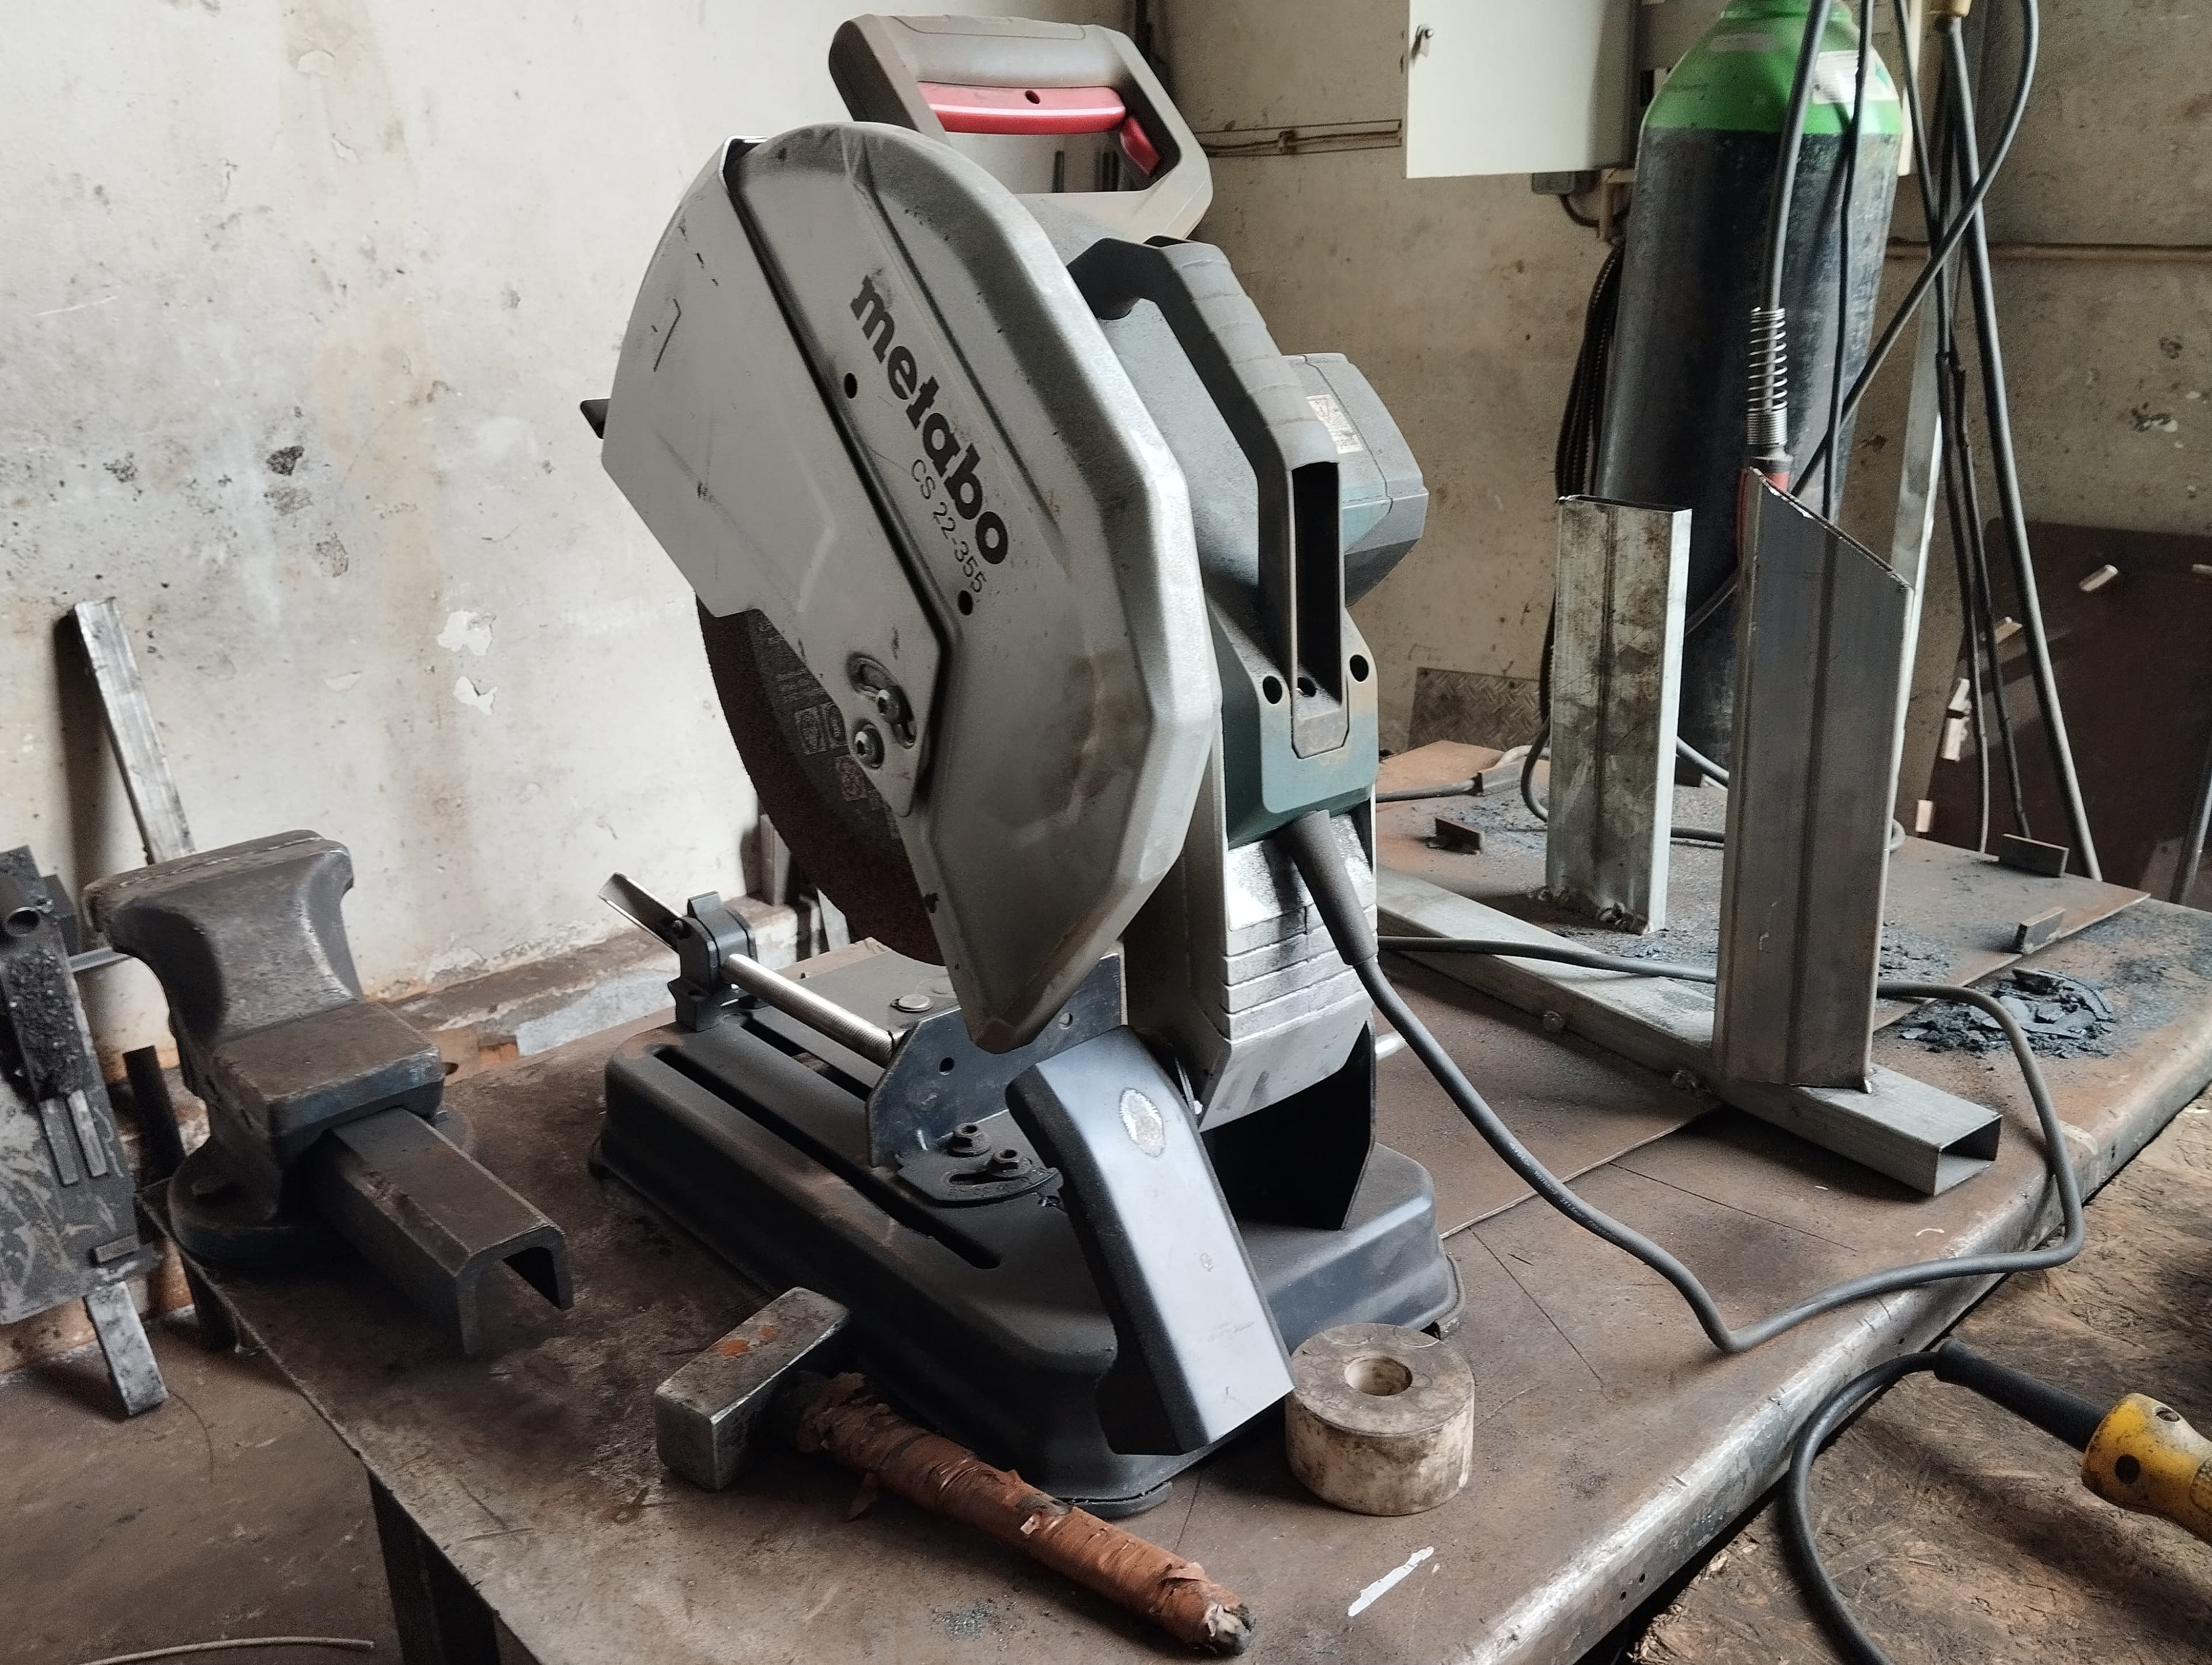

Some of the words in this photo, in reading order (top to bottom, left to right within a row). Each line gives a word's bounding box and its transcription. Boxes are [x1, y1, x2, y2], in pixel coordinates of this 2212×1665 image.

[850, 274, 1009, 565] metabo
[911, 458, 935, 500] CS
[932, 501, 987, 594] 22-355
